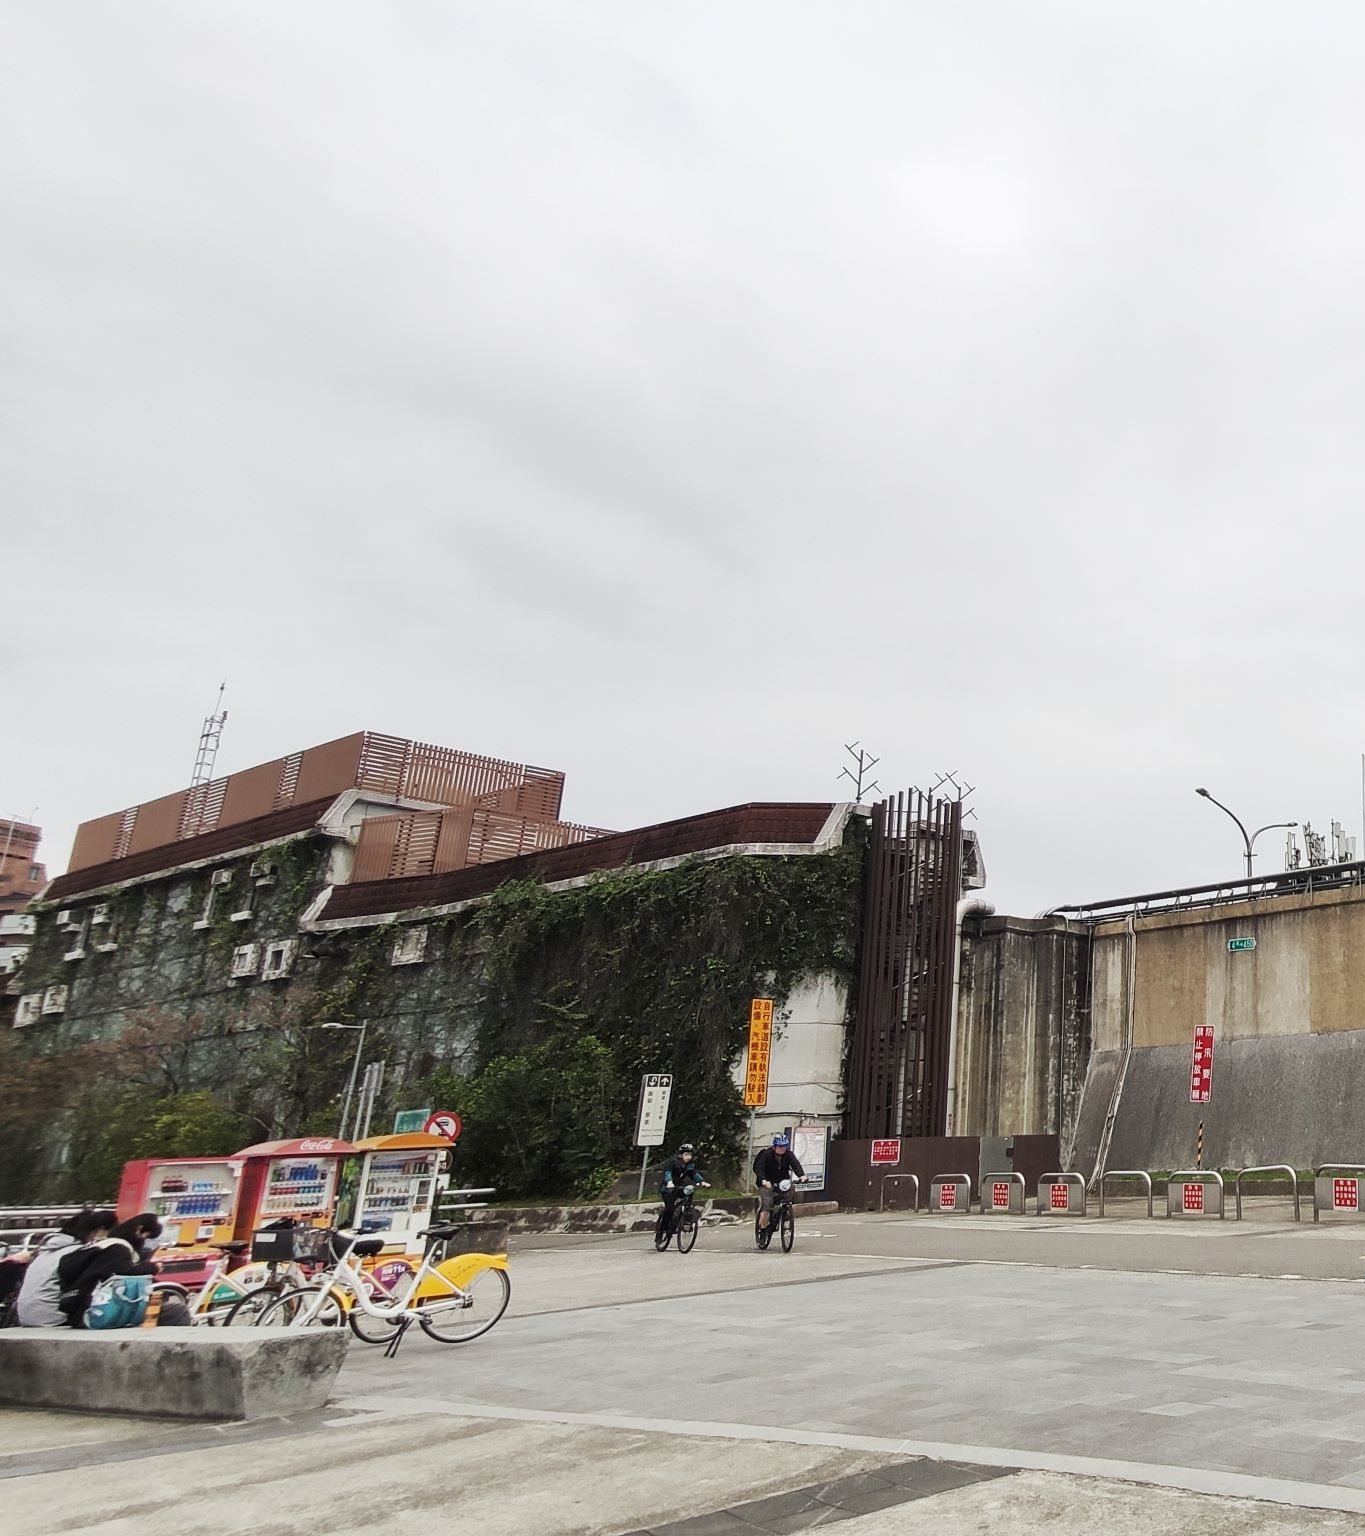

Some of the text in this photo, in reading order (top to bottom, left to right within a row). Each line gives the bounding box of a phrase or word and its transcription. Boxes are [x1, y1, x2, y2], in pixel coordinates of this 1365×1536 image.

[1192, 1027, 1204, 1100] 禁止停放車輛
[1201, 1027, 1213, 1100] 防汛要地
